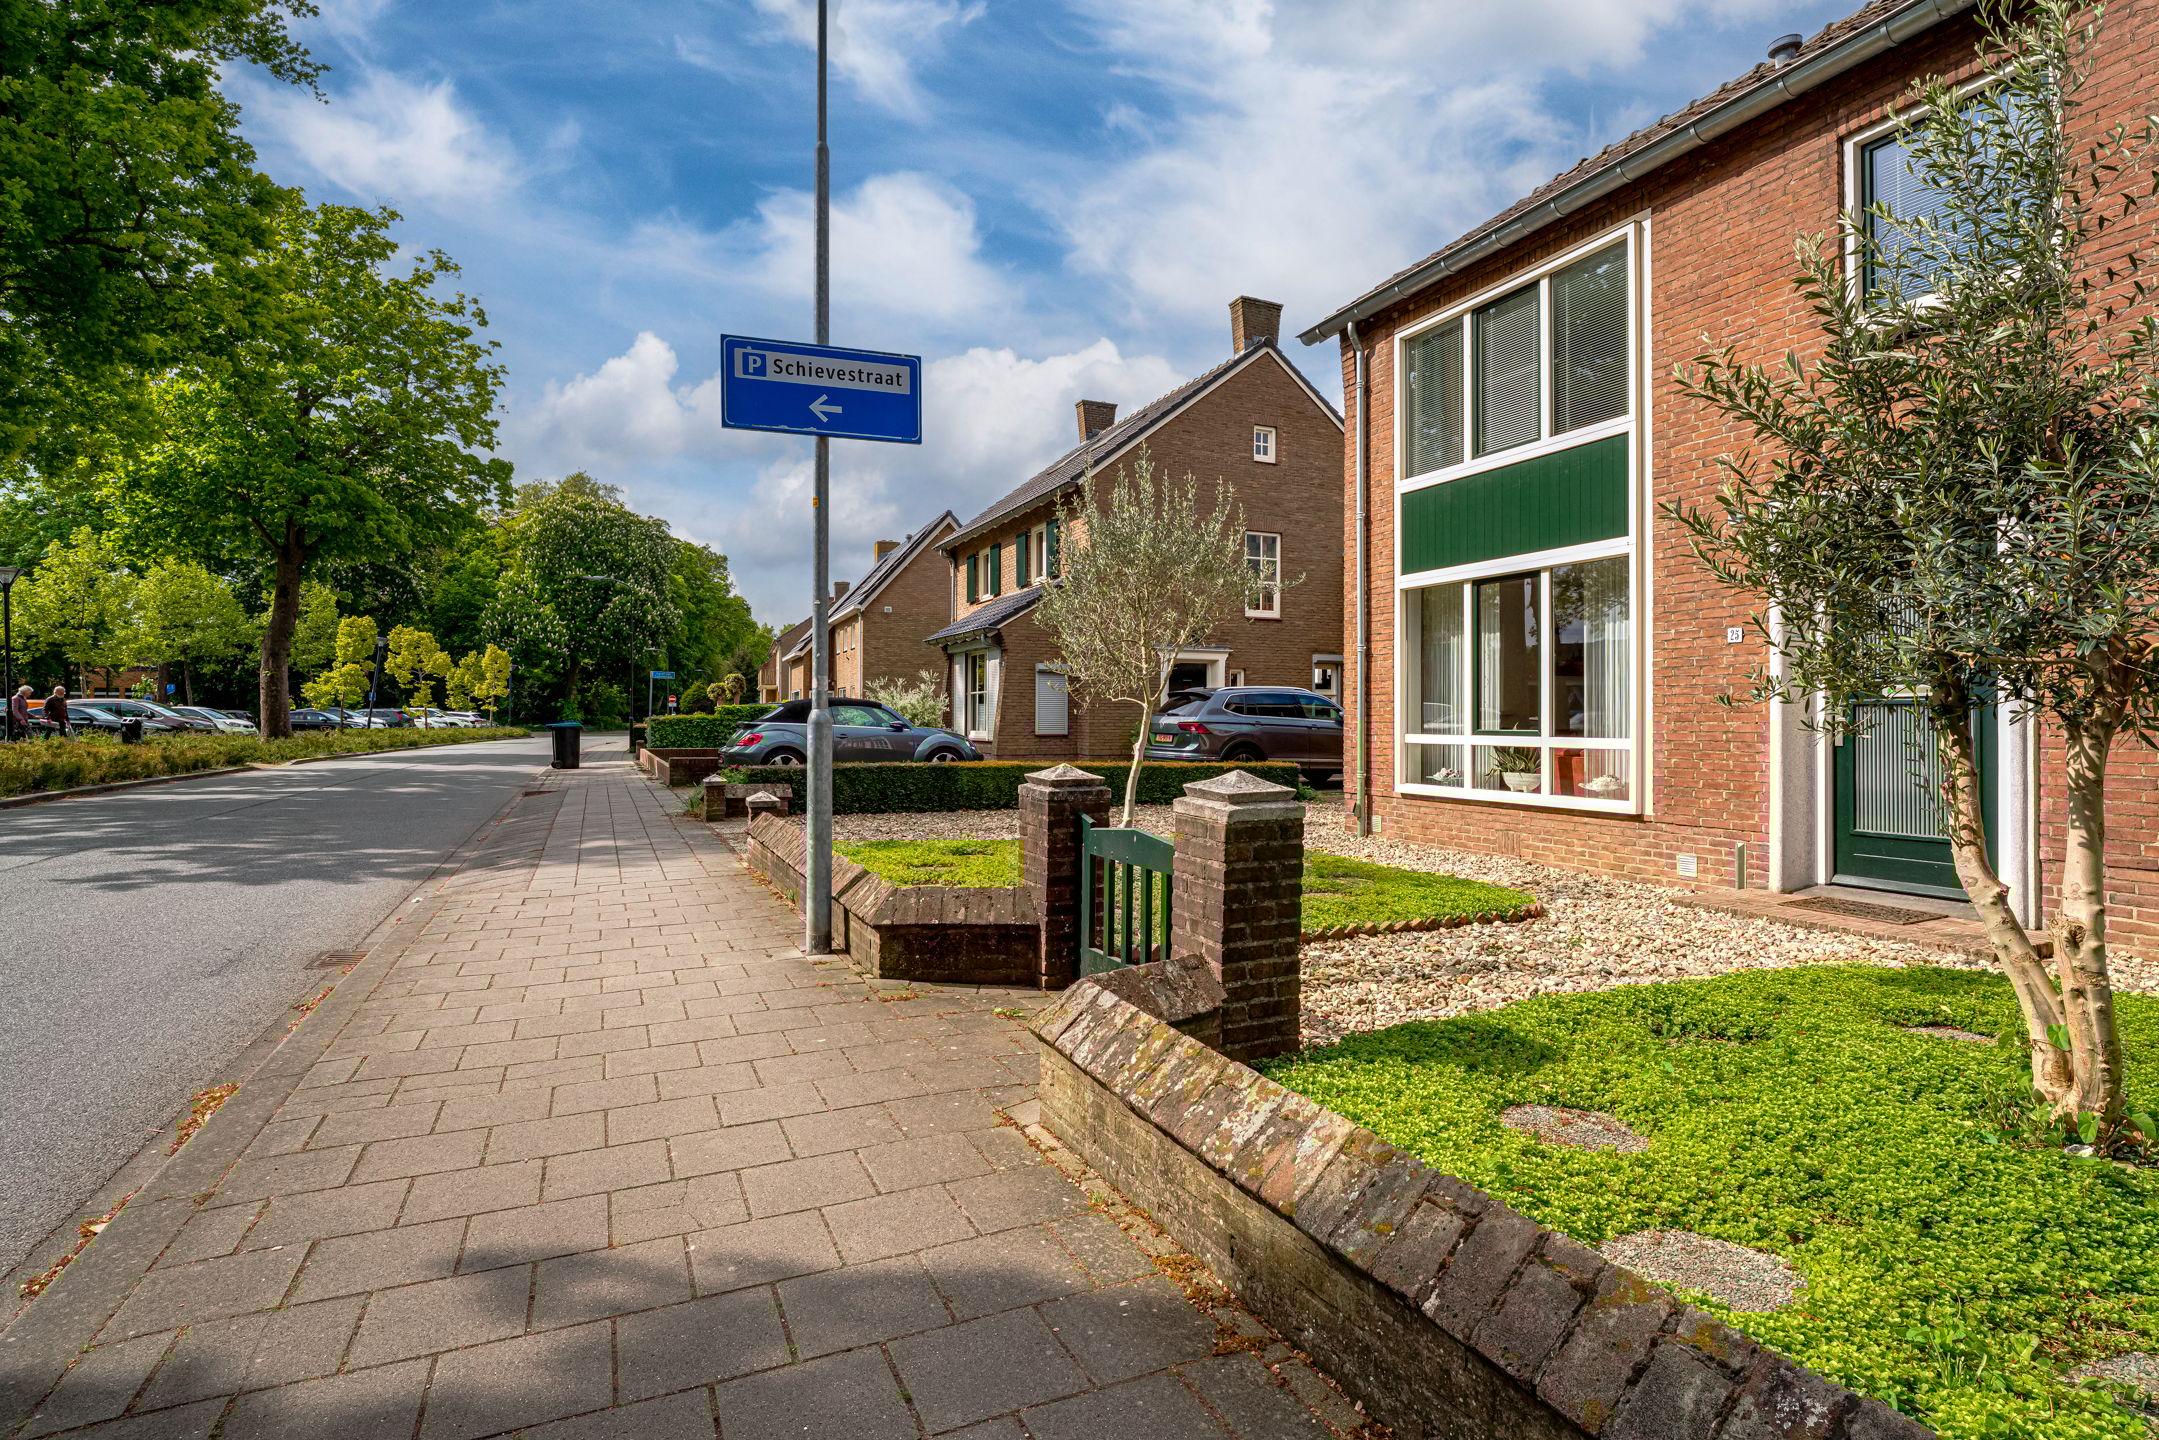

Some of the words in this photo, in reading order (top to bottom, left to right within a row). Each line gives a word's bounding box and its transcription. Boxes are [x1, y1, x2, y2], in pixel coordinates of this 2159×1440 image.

[748, 355, 762, 373] P
[773, 358, 903, 387] Schievestraat
[1730, 629, 1740, 641] 25
